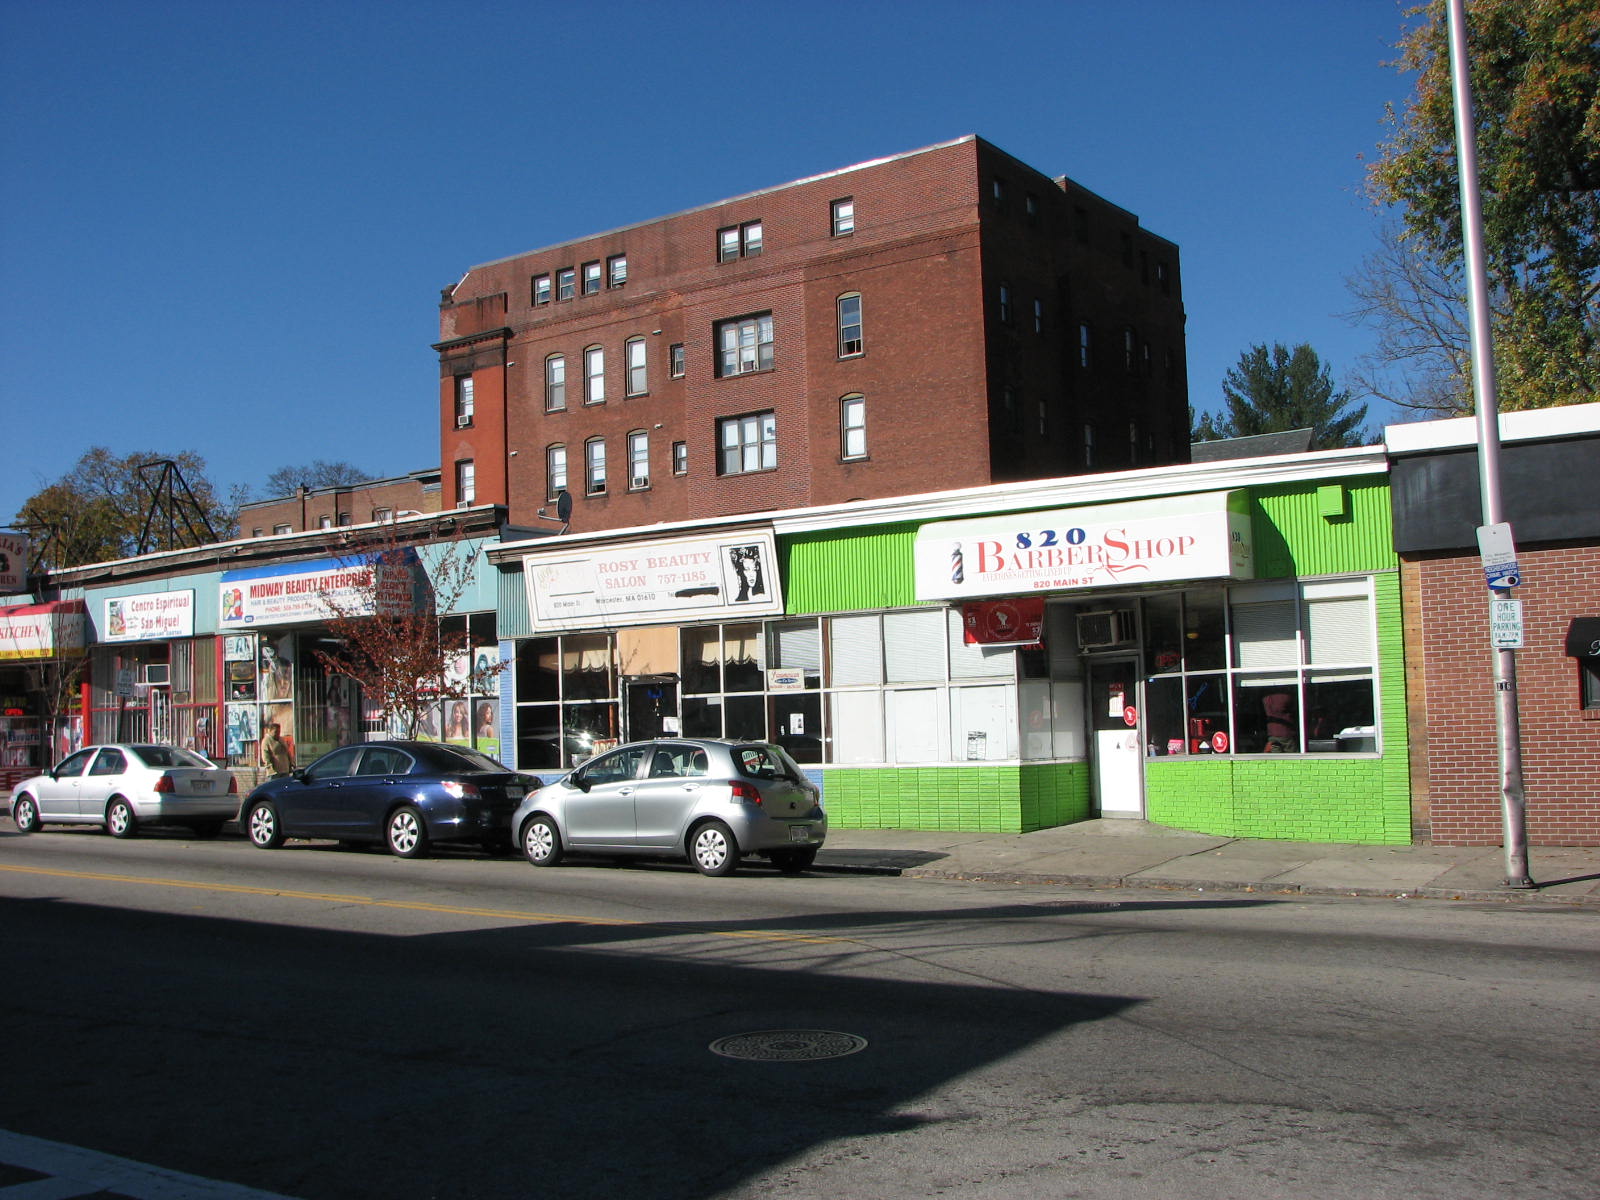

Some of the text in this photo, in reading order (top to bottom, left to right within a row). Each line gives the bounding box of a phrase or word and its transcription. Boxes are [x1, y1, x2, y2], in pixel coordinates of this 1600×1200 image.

[1016, 528, 1086, 549] 820
[599, 551, 712, 574] ROSY BEAUTY
[250, 581, 284, 599] MIDWAY
[285, 577, 318, 595] BEAUTY
[605, 570, 706, 589] SALON 757-1185
[1033, 576, 1095, 589] 820 MAIN ST
[131, 594, 190, 613] Centro Espiritual
[1497, 602, 1515, 612] ONE
[155, 614, 180, 632] Miguel
[1496, 612, 1516, 622] HOUR
[1492, 622, 1521, 632] PARKING
